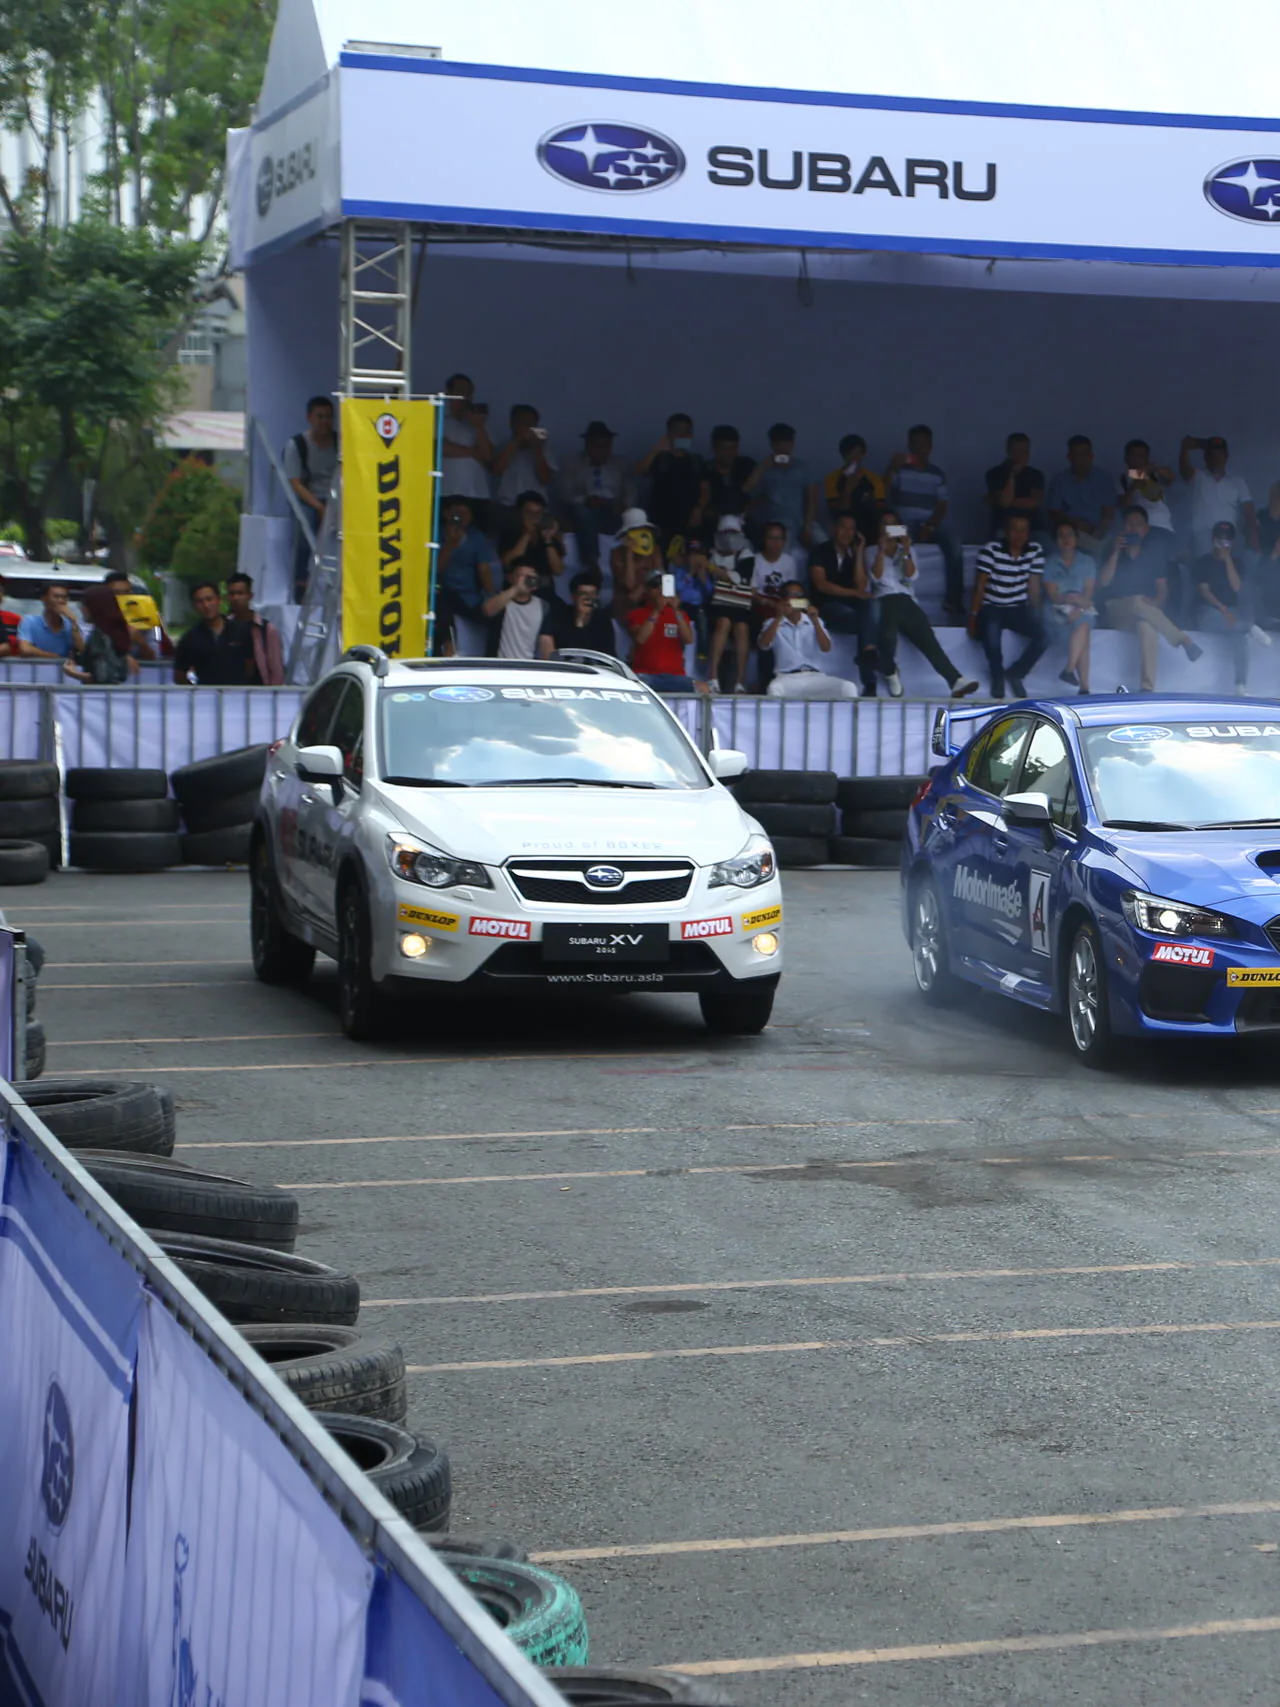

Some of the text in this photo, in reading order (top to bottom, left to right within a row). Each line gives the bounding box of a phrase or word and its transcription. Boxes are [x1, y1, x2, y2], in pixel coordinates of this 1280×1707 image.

[707, 145, 997, 201] SUBARU
[501, 687, 650, 705] SUBARU
[953, 864, 1022, 919] MotorImage
[408, 909, 457, 926] DUNLOP
[471, 919, 529, 938] MOTUL
[684, 918, 731, 938] MOTUL
[569, 934, 644, 946] SUBARU XV
[1156, 945, 1211, 965] MOTUL
[547, 973, 664, 983] www.Subaru.asia
